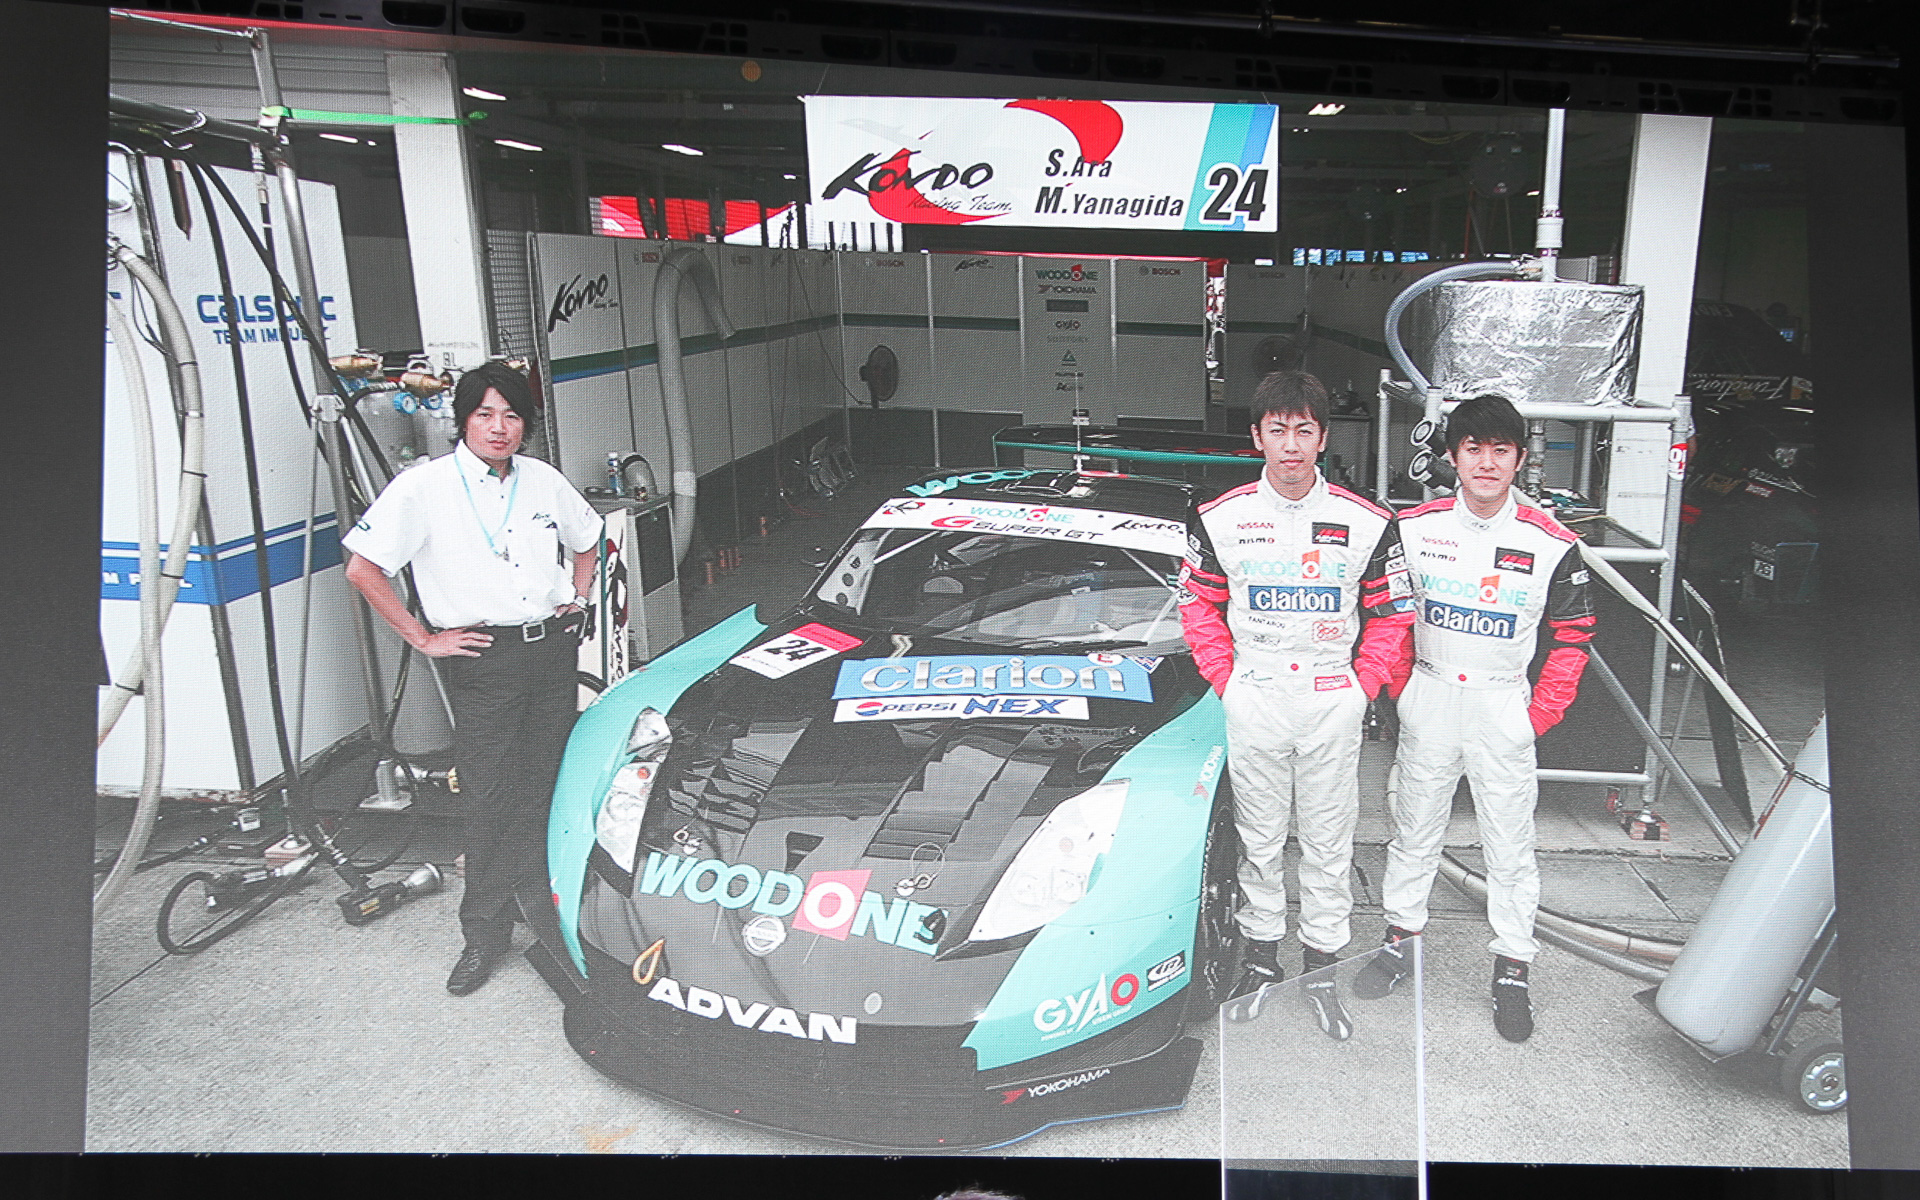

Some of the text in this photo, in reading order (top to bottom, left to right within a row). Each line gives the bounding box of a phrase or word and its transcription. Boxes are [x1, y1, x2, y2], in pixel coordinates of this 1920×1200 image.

[1035, 186, 1185, 218] M.Yanagida
[1202, 167, 1270, 222] 24
[970, 506, 1075, 525] WOODONE
[1237, 522, 1275, 530] NISSAN
[975, 521, 1062, 536] SUPER
[1067, 529, 1105, 541] GT
[1421, 536, 1459, 548] NISSAN
[1240, 560, 1347, 579] WOODONE
[1254, 586, 1335, 611] clarion
[1421, 574, 1529, 606] WOODONE
[1430, 604, 1511, 638] clarion
[765, 638, 823, 662] 24
[860, 655, 1124, 692] clarion
[880, 697, 1068, 716] PEPSI NEX
[639, 851, 949, 956] WOODONE
[647, 976, 857, 1045] ADVAN
[1027, 1068, 1111, 1098] YOKOHAMA
